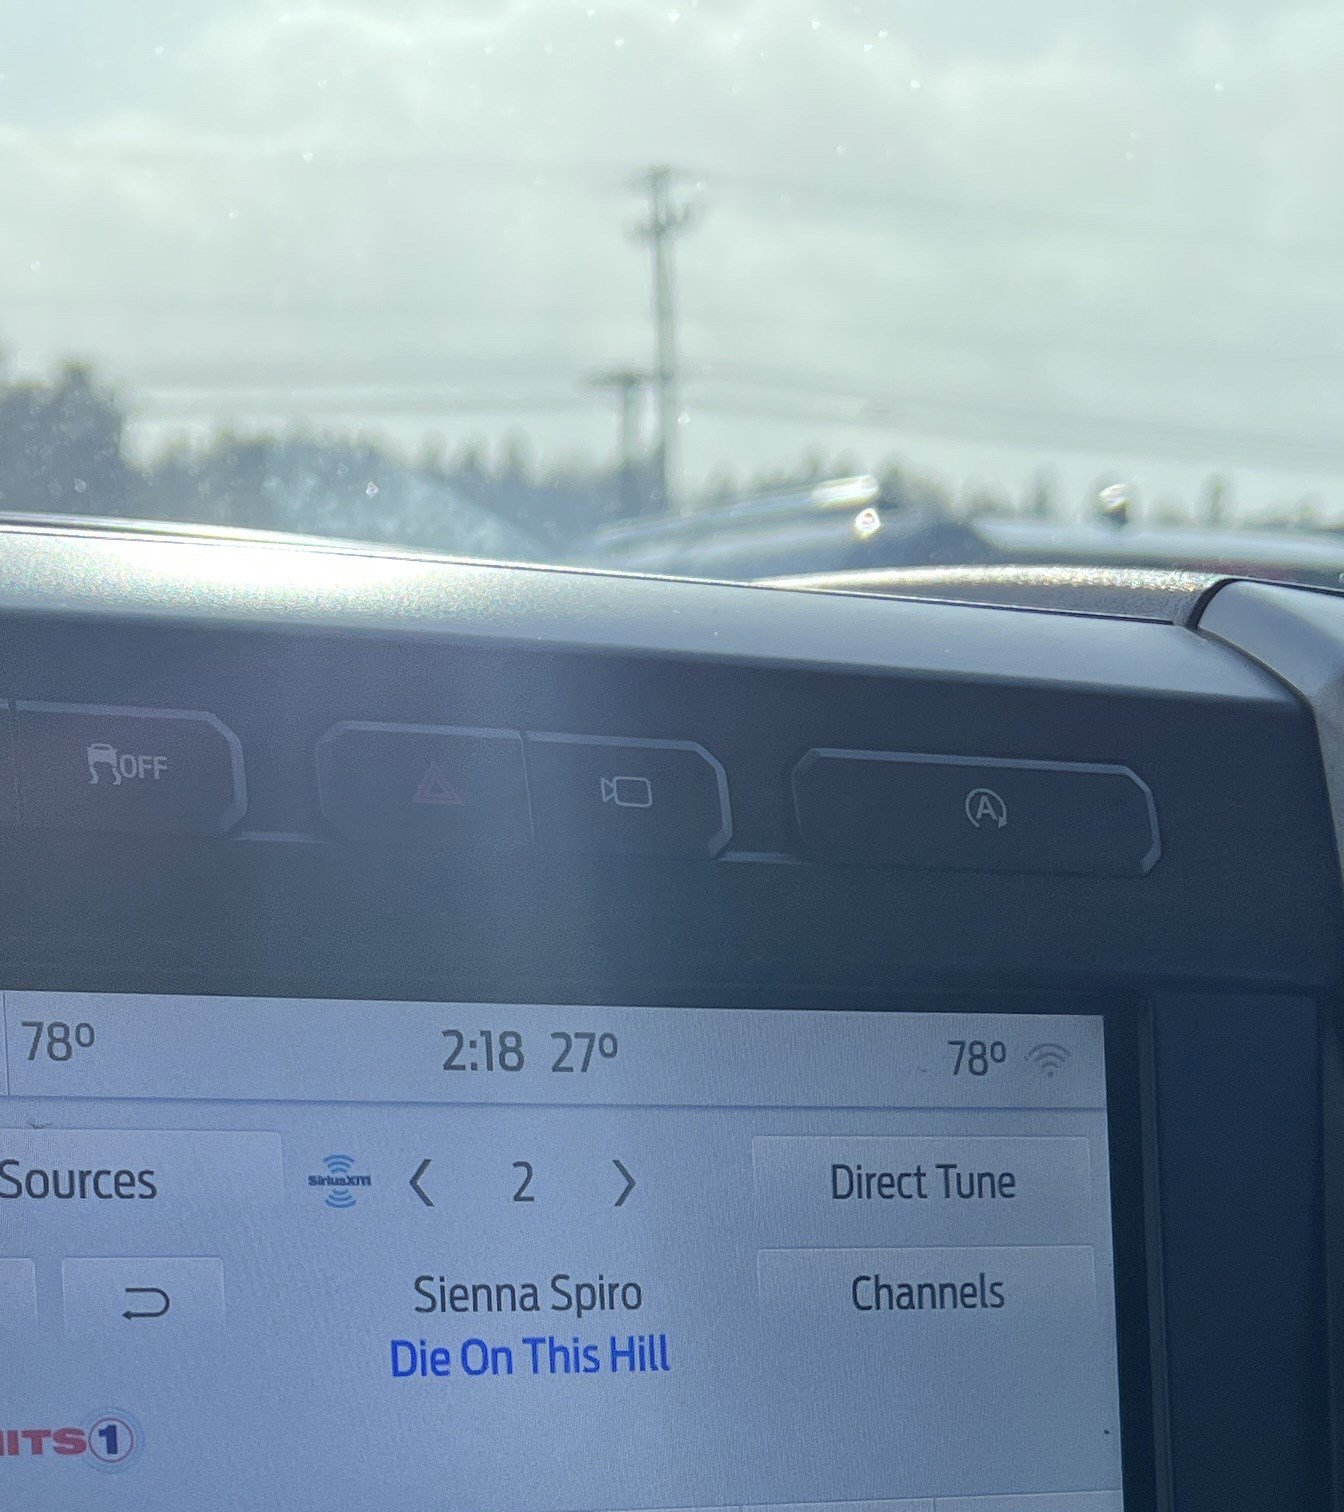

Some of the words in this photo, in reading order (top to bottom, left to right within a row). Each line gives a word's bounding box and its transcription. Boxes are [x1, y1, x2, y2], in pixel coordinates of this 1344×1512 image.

[118, 752, 168, 781] OFF
[442, 1030, 524, 1071] 2:18
[513, 1161, 535, 1202] 2
[831, 1164, 927, 1200] Direct
[935, 1164, 1017, 1199] Tune
[414, 1275, 540, 1313] Sienna
[550, 1273, 642, 1318] Spiro
[851, 1273, 1005, 1311] Channels
[391, 1338, 451, 1377] Die
[460, 1338, 513, 1375] On
[522, 1336, 600, 1374] This
[610, 1334, 670, 1373] Hill
